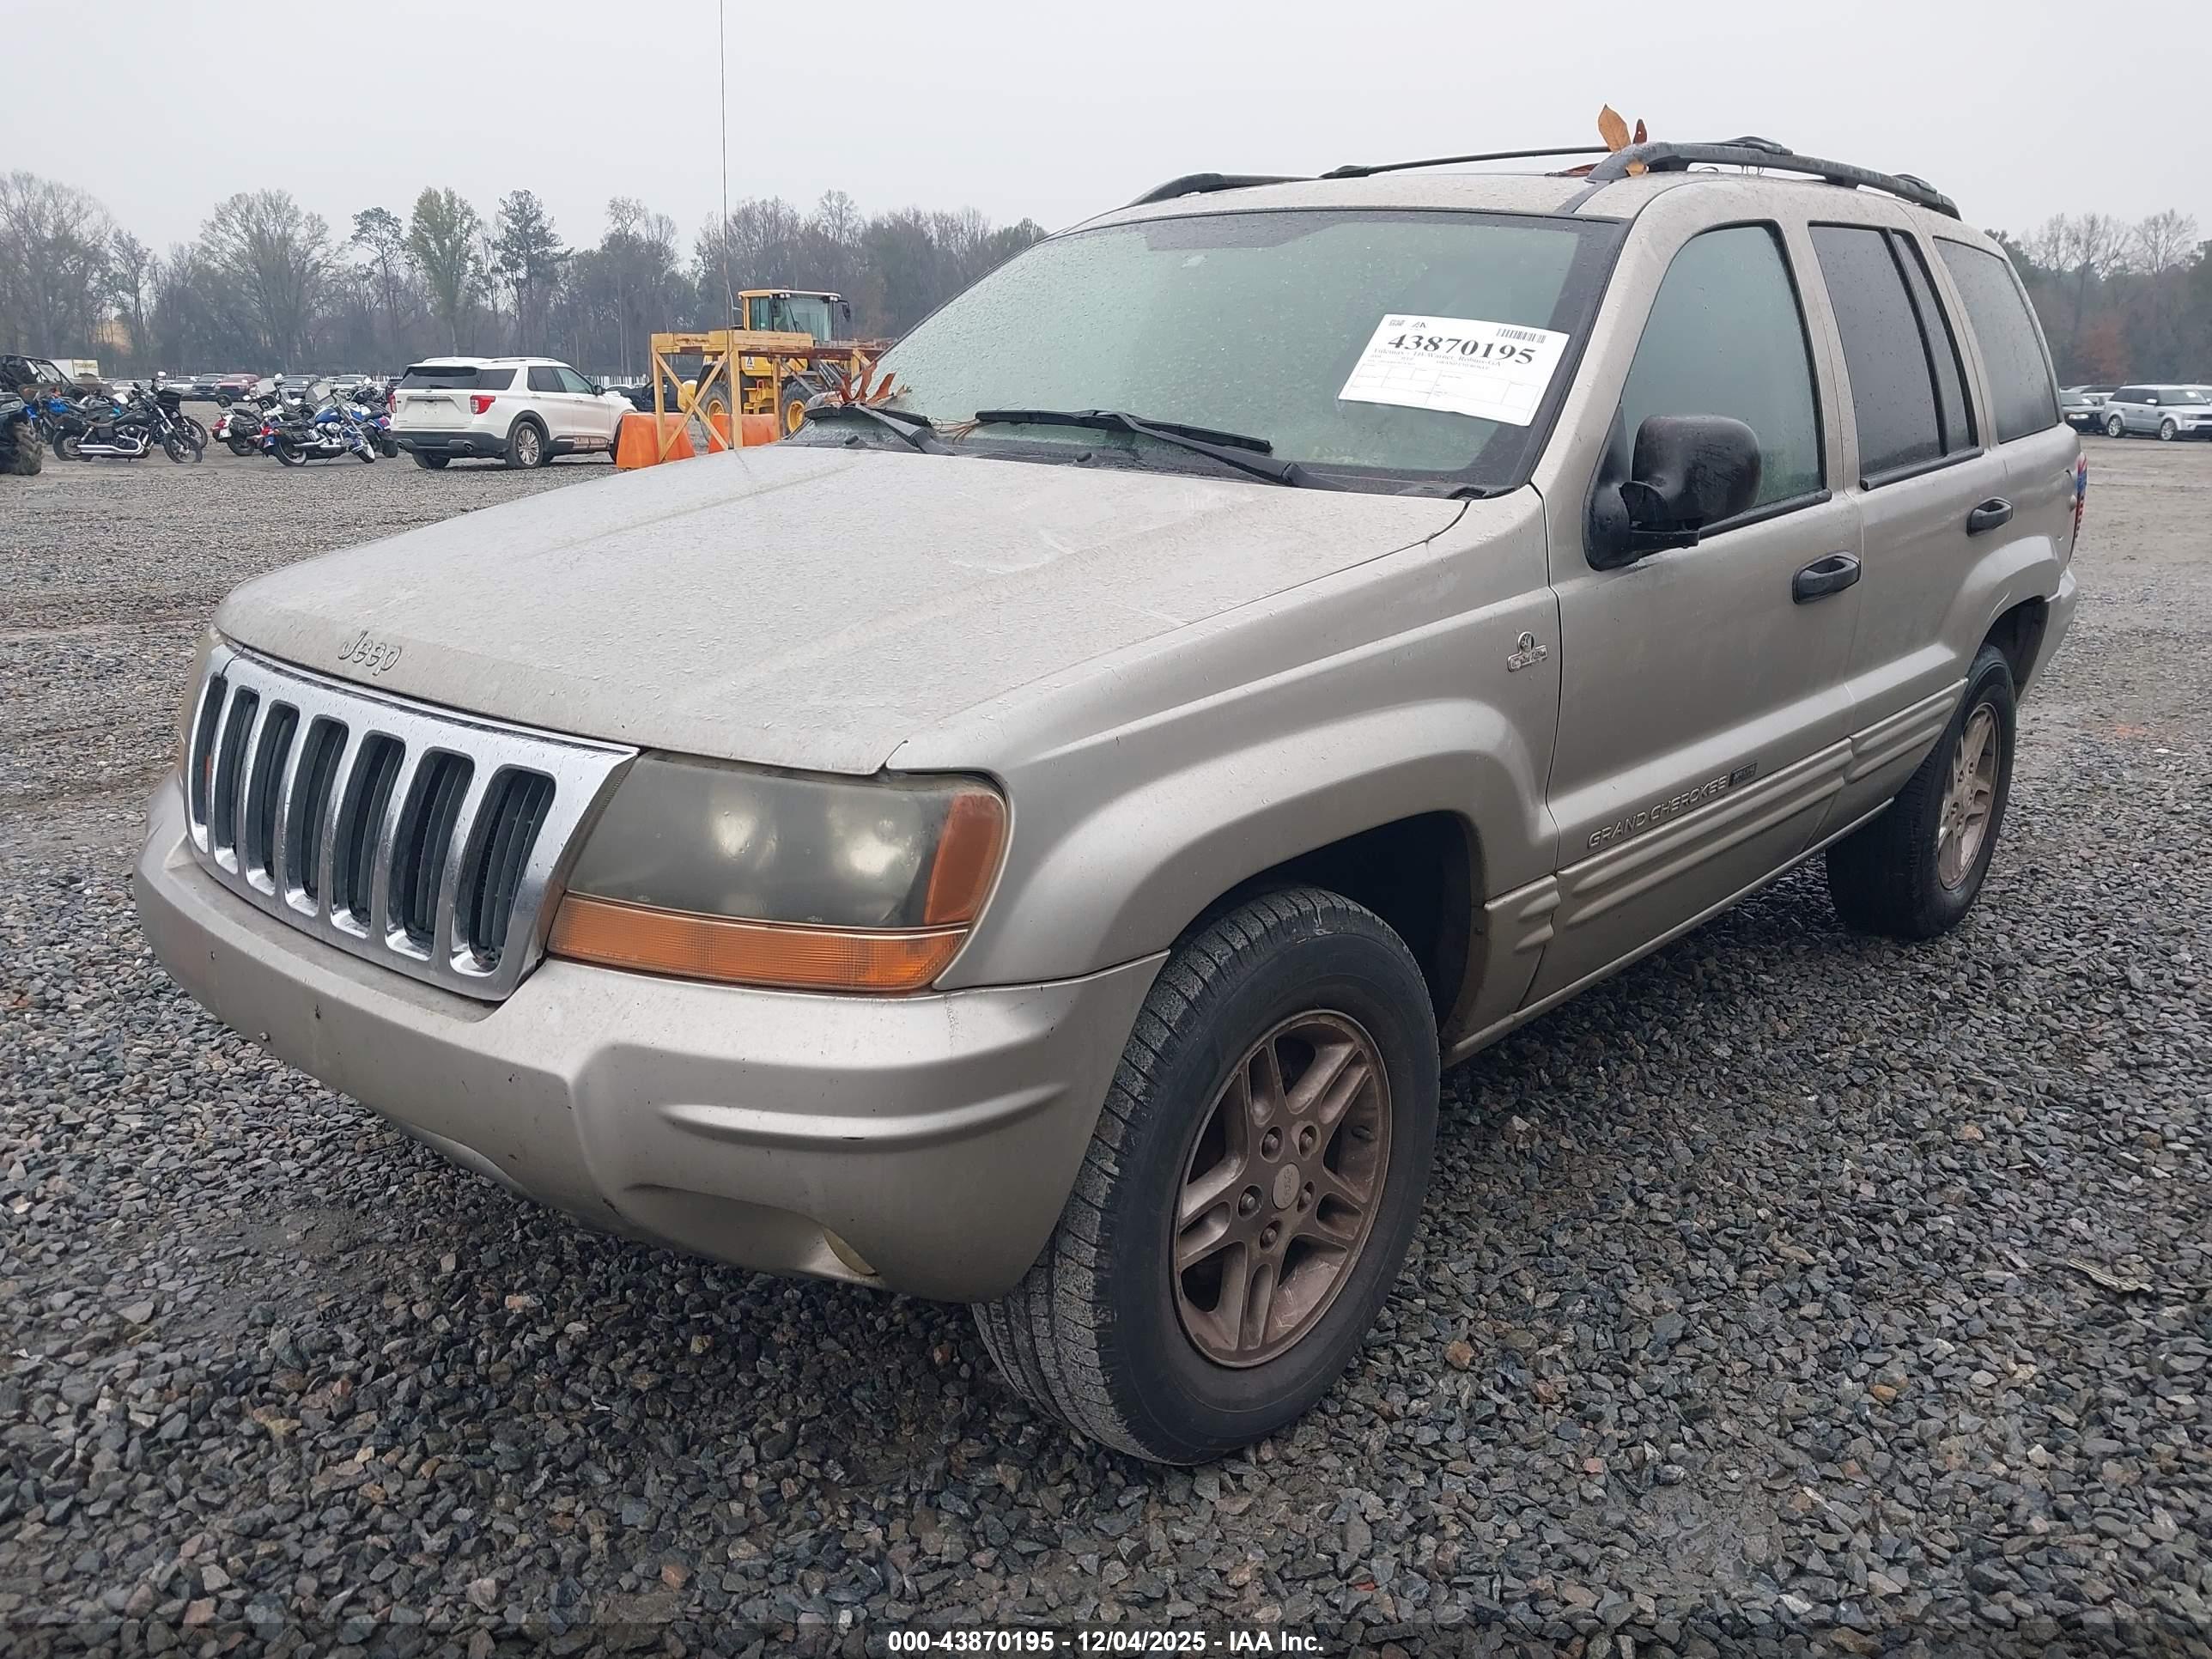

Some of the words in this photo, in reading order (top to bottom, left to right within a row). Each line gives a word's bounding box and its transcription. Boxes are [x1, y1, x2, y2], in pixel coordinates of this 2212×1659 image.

[1387, 333, 1537, 364] 43870195
[337, 630, 402, 677] Jeep
[1587, 811, 1647, 849] GRAND
[1649, 775, 1729, 822] CHEROKEE
